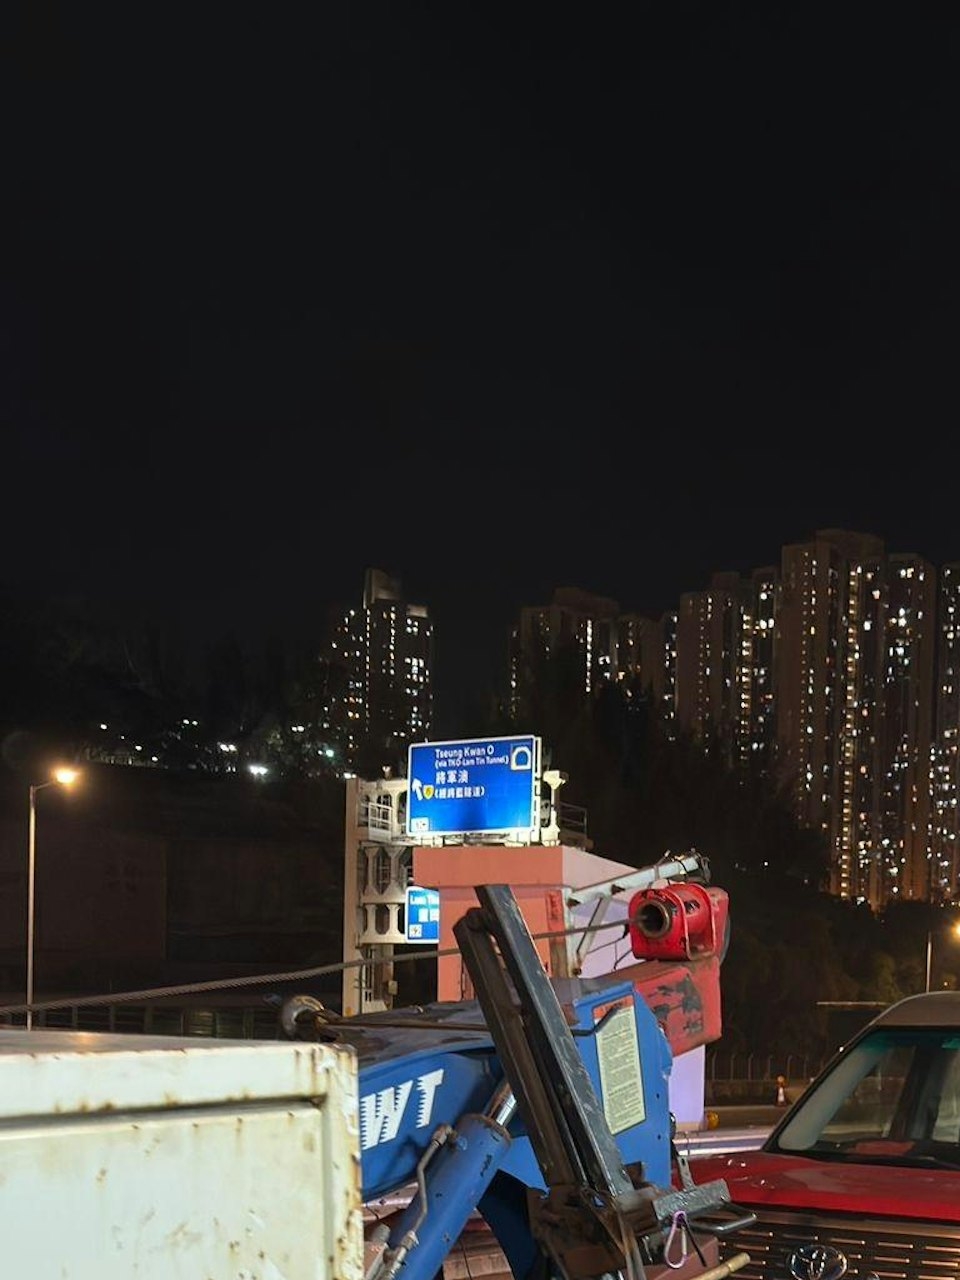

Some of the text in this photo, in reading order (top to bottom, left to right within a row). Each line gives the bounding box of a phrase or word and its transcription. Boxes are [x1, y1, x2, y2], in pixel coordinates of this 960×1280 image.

[435, 744, 495, 759] Tseung Kwan O
